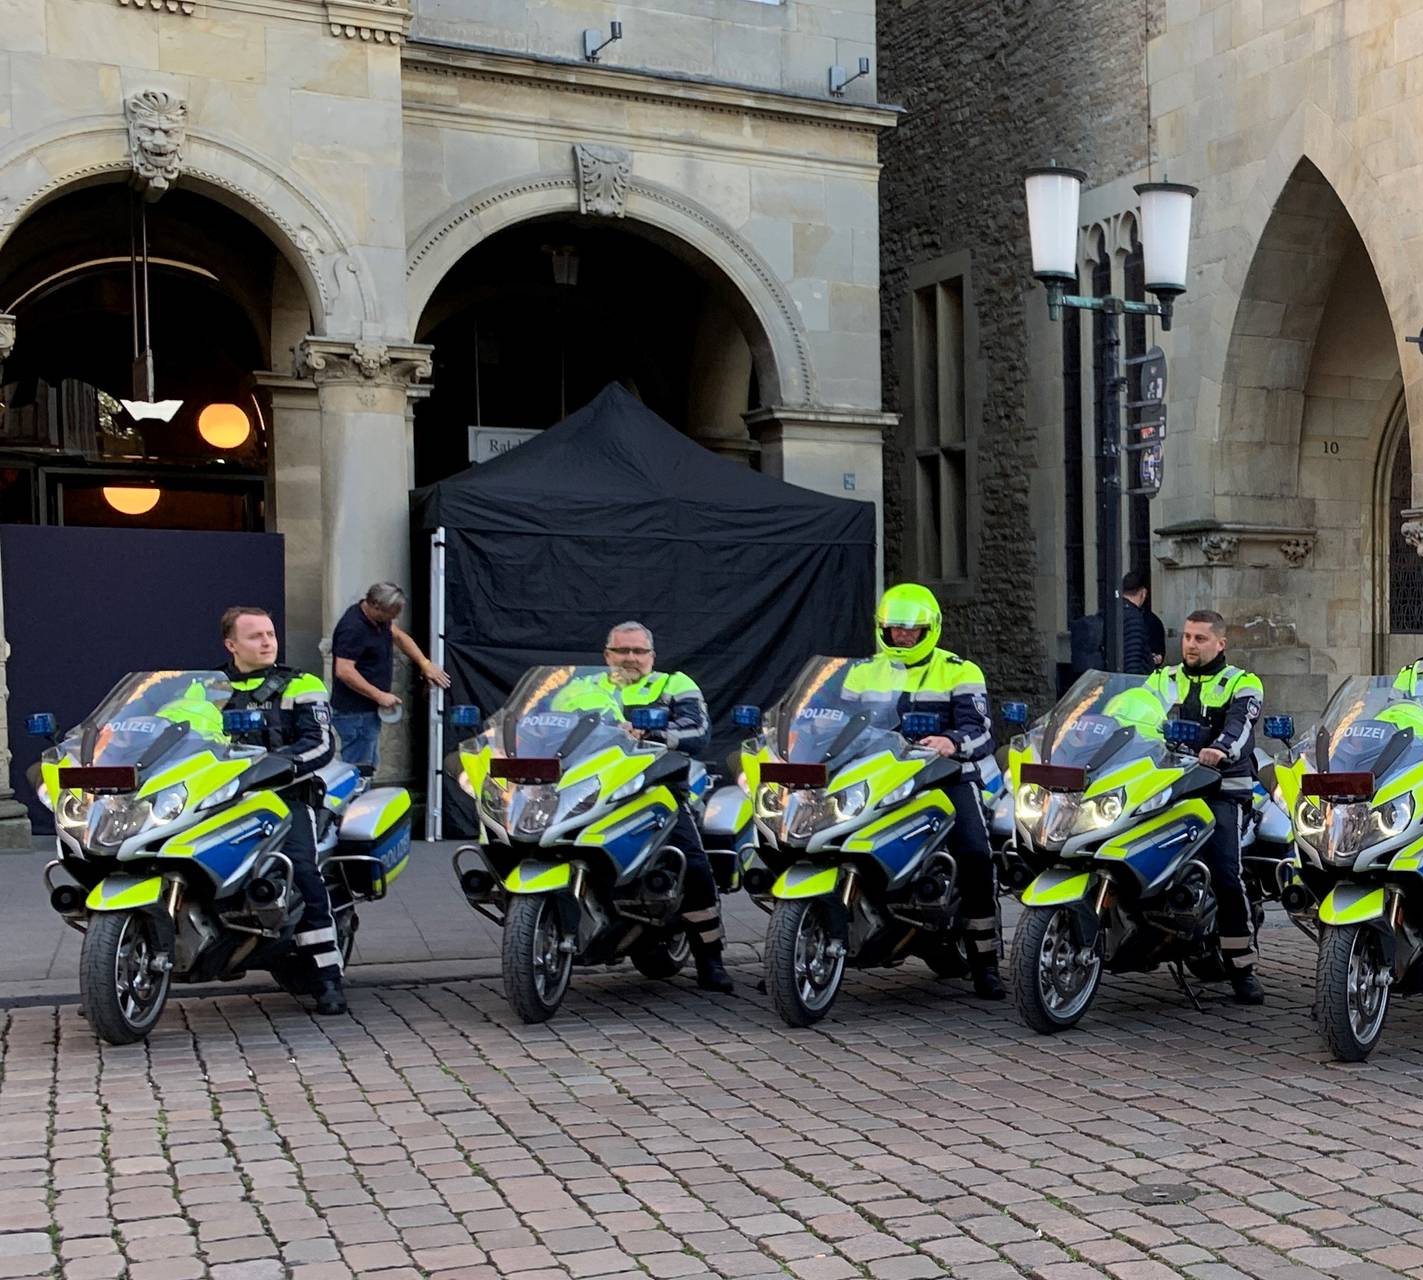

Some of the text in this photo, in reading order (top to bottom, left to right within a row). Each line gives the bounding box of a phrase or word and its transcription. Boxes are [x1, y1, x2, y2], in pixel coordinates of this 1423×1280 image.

[1323, 441, 1339, 454] 10
[522, 715, 571, 728] POLIZEI
[797, 709, 845, 722] POLIZEI
[106, 721, 156, 733] POLIZEI
[1065, 720, 1107, 736] OLIEI
